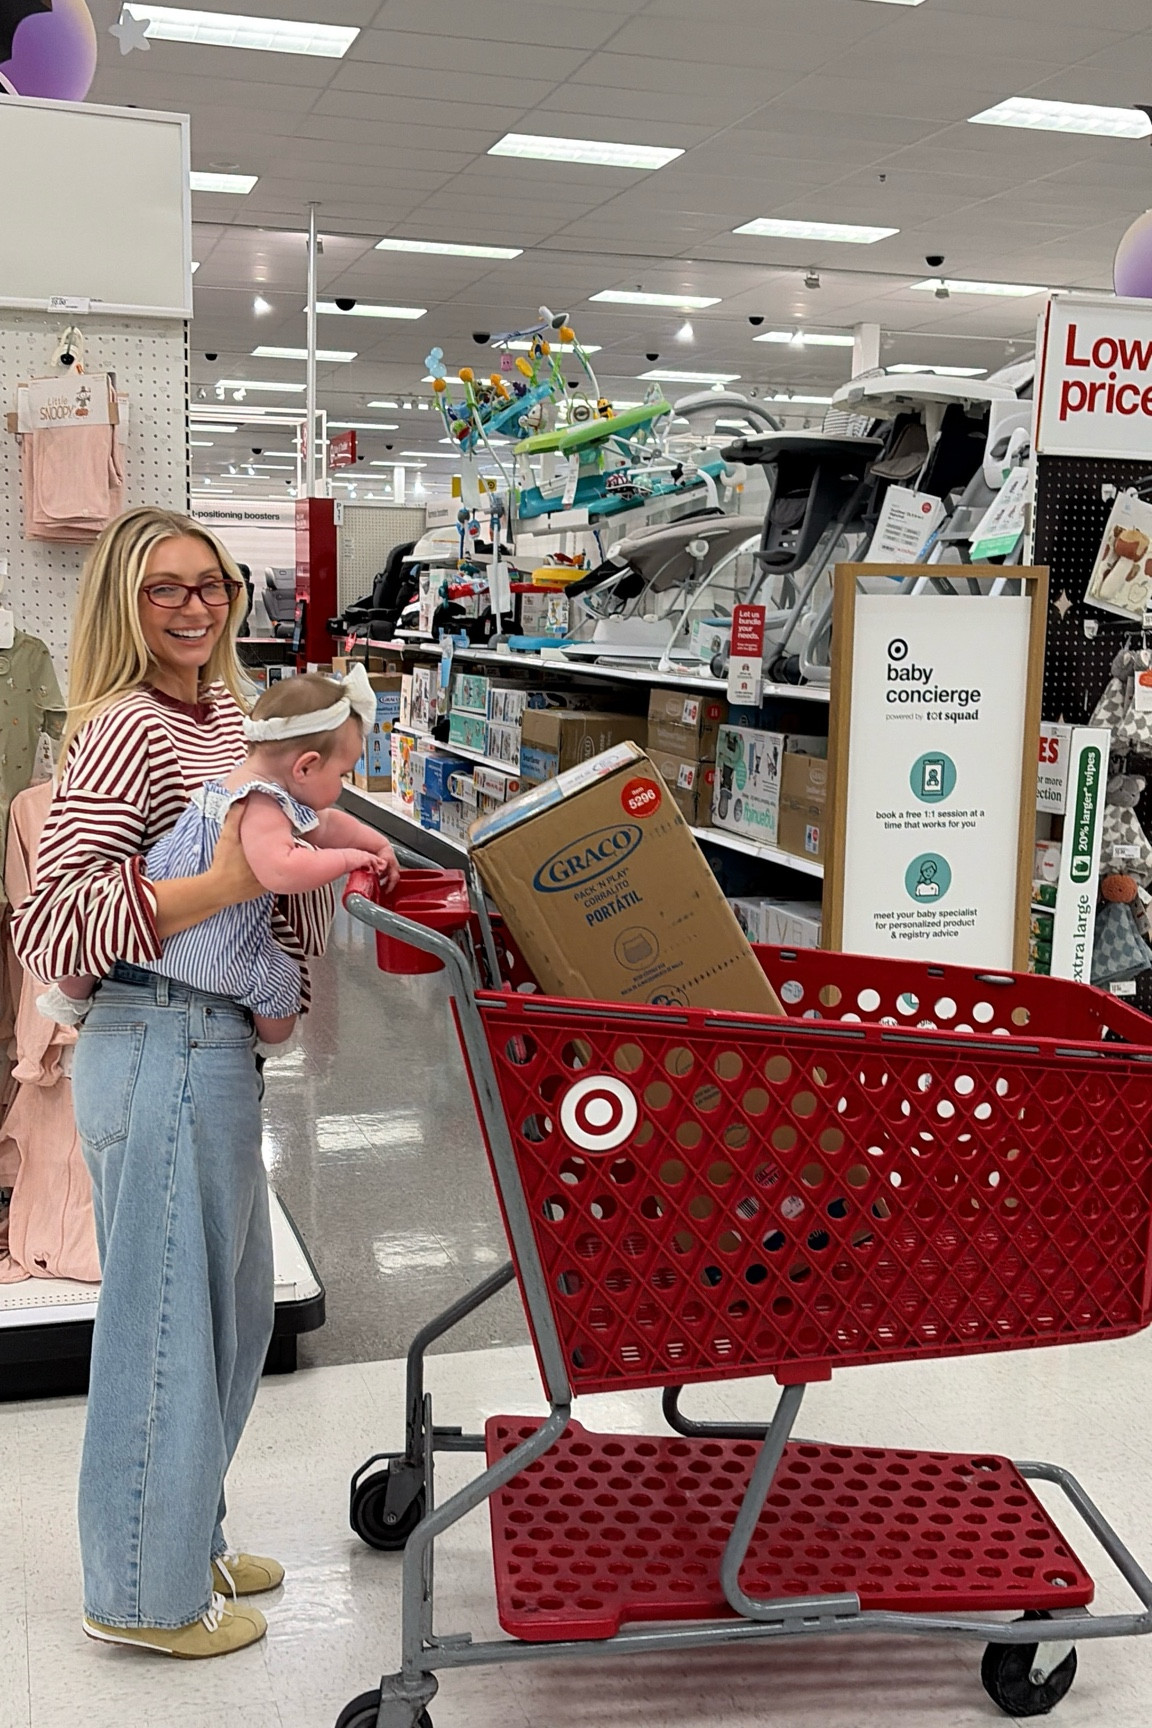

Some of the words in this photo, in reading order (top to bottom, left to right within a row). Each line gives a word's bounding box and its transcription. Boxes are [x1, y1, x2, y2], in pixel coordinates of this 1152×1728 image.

[1065, 323, 1152, 371] Low
[40, 405, 73, 421] SNOOPY
[244, 511, 280, 520] boosters
[738, 610, 751, 618] Let
[738, 617, 762, 626] bundle
[738, 625, 754, 633] your
[887, 663, 934, 685] baby
[886, 684, 981, 707] concierge
[885, 712, 914, 721] powered
[915, 711, 923, 721] by
[926, 711, 942, 721] tot
[944, 709, 979, 724] squad
[1044, 776, 1063, 787] more
[628, 788, 656, 810] 5296
[1078, 827, 1090, 852] 20%
[1084, 751, 1096, 786] wipes
[875, 811, 896, 819] book
[898, 811, 904, 819] a
[905, 810, 922, 818] free
[924, 810, 935, 818] 1:1
[937, 809, 968, 818] session
[969, 809, 978, 817] at
[884, 820, 902, 829] time
[904, 820, 920, 829] that
[922, 820, 947, 829] works
[948, 819, 959, 828] for
[961, 820, 976, 829] you
[548, 829, 632, 884] GRACO
[574, 885, 596, 902] PACK
[584, 879, 630, 908] CORRALITO
[585, 890, 643, 927] PORTÁTIL
[873, 911, 895, 919] meet
[896, 911, 915, 920] your
[916, 909, 937, 919] baby
[938, 908, 978, 917] specialist
[1073, 893, 1092, 939] large
[875, 921, 887, 930] for
[888, 919, 942, 930] personalized
[943, 918, 975, 928] product
[890, 930, 897, 939] &
[899, 929, 931, 940] registry
[932, 928, 959, 938] advice
